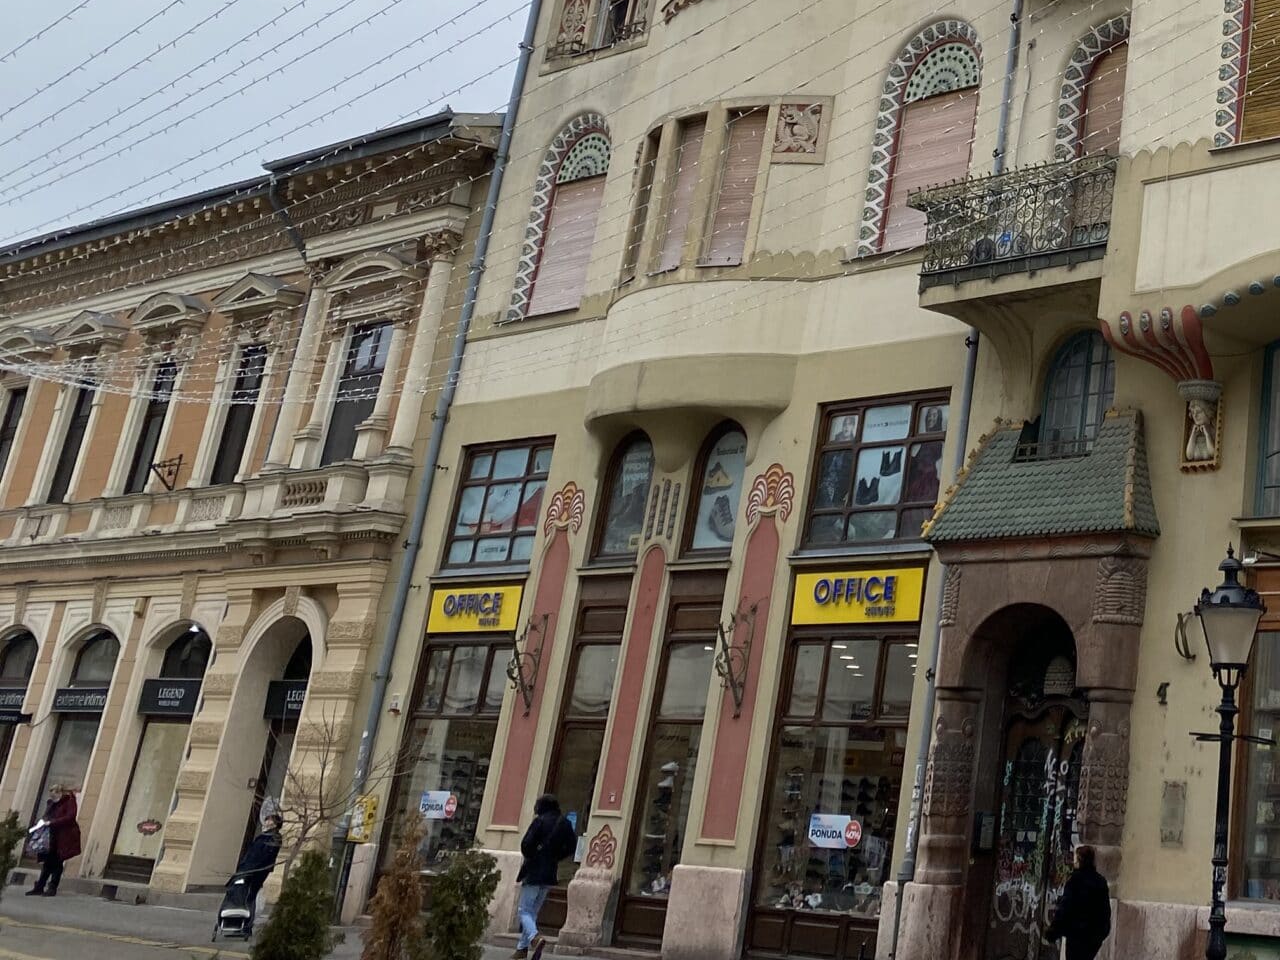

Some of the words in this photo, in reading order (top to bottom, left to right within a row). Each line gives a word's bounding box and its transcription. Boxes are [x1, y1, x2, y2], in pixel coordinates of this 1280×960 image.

[813, 576, 898, 605] OFFICE
[443, 592, 504, 618] OFFICE
[158, 688, 185, 699] LEGEND
[811, 829, 842, 839] PONUDA
